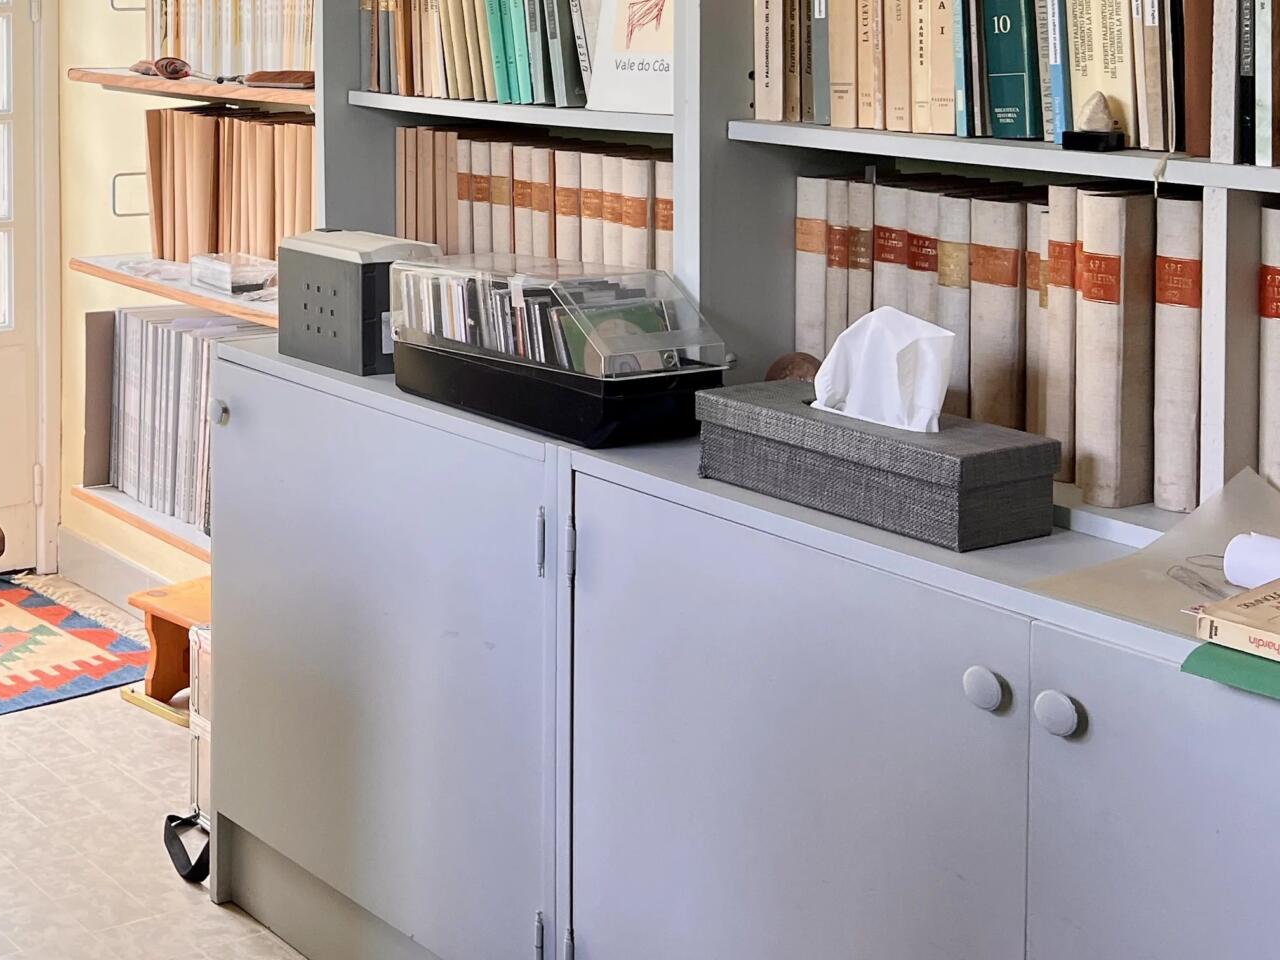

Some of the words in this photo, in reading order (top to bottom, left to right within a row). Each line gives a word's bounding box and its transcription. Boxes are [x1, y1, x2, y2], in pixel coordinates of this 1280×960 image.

[992, 15, 1011, 34] 10
[1086, 16, 1092, 26] LA
[1115, 17, 1122, 27] LA
[861, 31, 869, 43] LA
[939, 27, 946, 35] I
[1079, 20, 1087, 63] GIACIMENTO
[1086, 26, 1094, 53] ISERNIA
[1109, 21, 1117, 65] GIACIMENTO
[615, 58, 636, 71] Vale
[637, 59, 651, 72] do
[652, 58, 670, 72] Côa
[1043, 77, 1053, 113] BLANC
